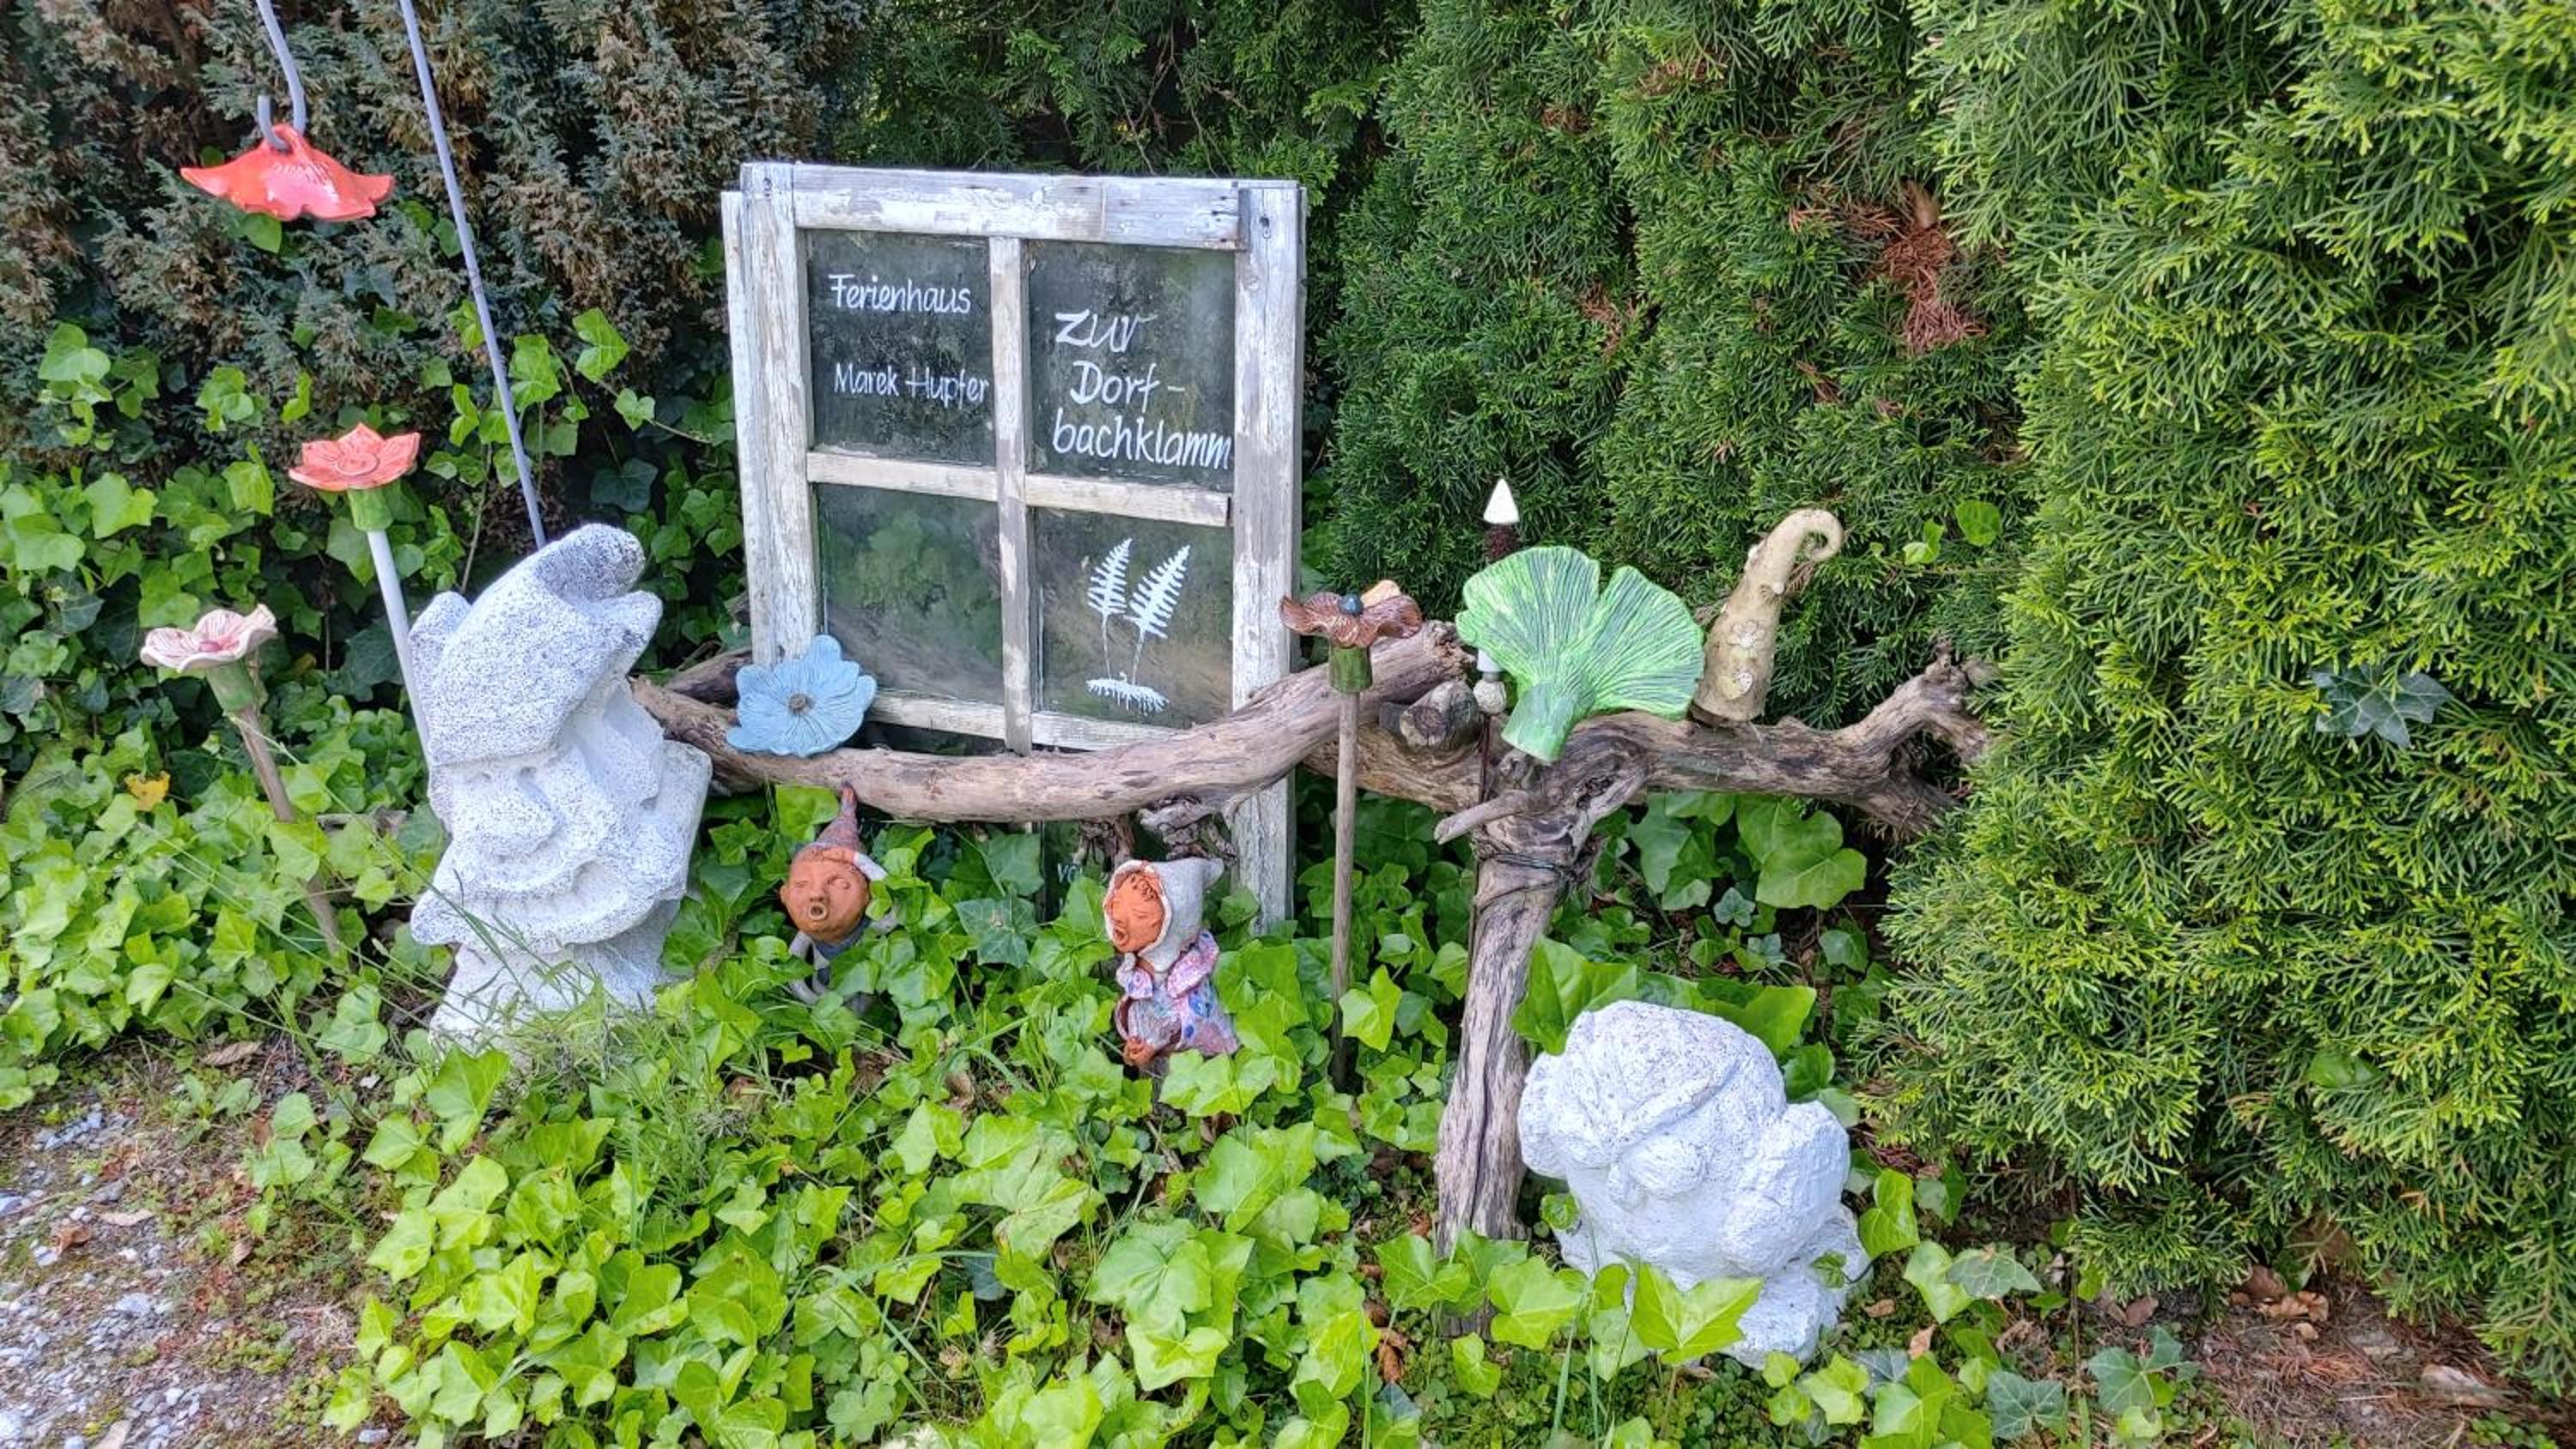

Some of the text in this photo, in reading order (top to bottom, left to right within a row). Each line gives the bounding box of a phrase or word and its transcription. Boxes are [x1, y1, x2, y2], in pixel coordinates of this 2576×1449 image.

[829, 274, 971, 313] Ferienhaus
[834, 362, 989, 410] Marek Hupfer
[1052, 408, 1231, 470] bachklamm
